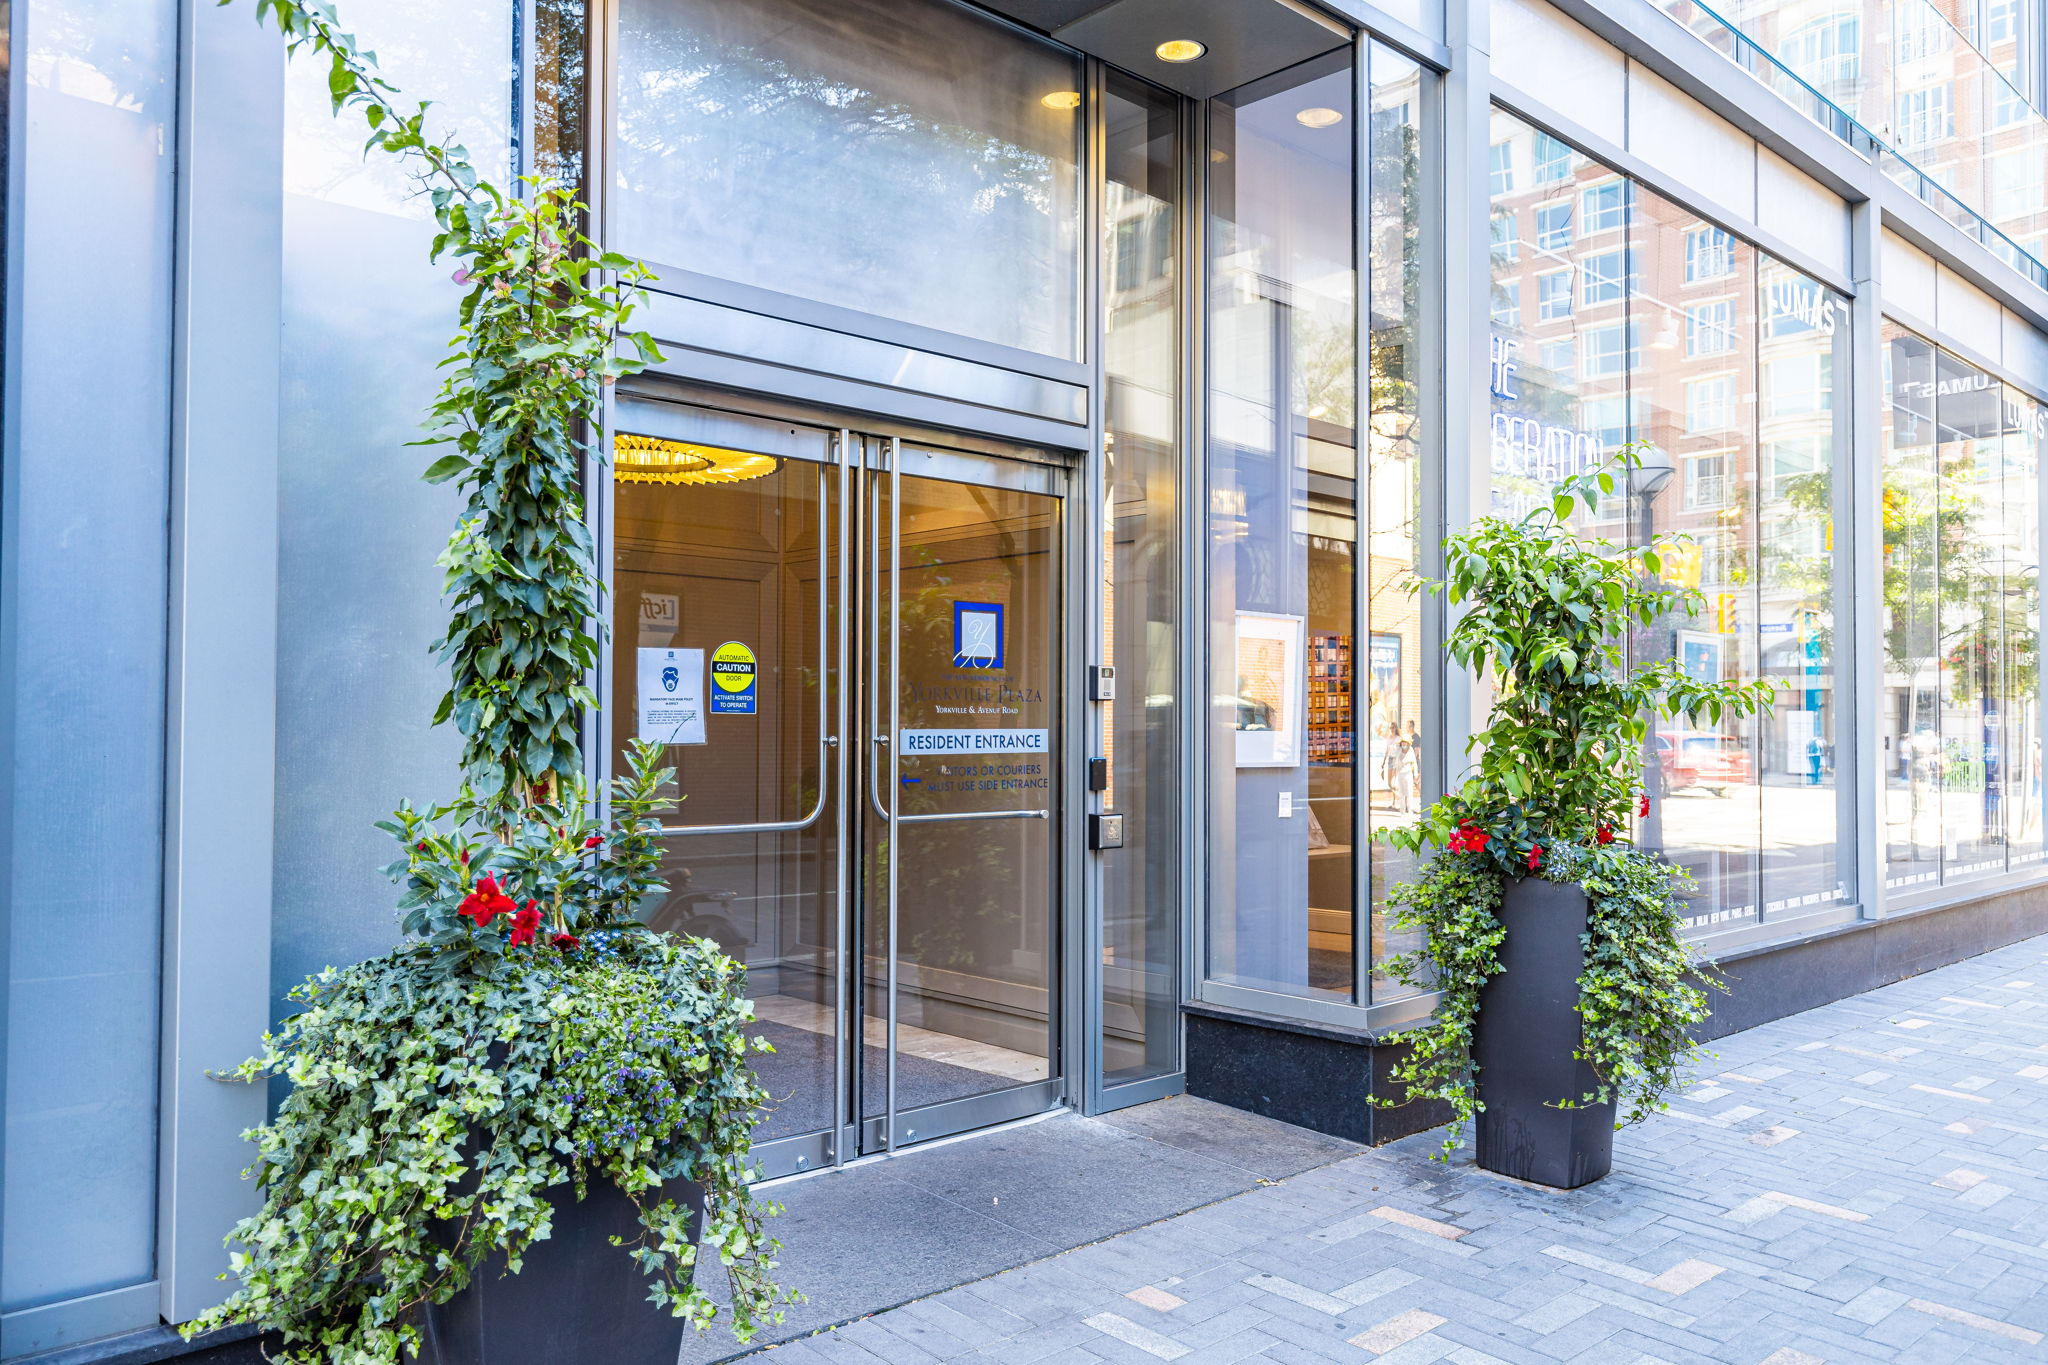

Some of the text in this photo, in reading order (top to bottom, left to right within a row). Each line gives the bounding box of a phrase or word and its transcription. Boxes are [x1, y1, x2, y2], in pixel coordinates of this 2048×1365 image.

[718, 654, 750, 662] AUTOMATIC
[716, 663, 752, 672] CAUTION
[999, 684, 1042, 704] PLAZA
[935, 705, 1019, 714] YORKVILLE & AVENUE ROAD
[908, 734, 1042, 750] RESIDENT ENTRANCE
[981, 765, 994, 776] OR
[996, 764, 1042, 775] COURIERS
[958, 780, 976, 792] USE
[978, 779, 998, 791] SIDE
[1001, 778, 1049, 790] ENTRANCE
